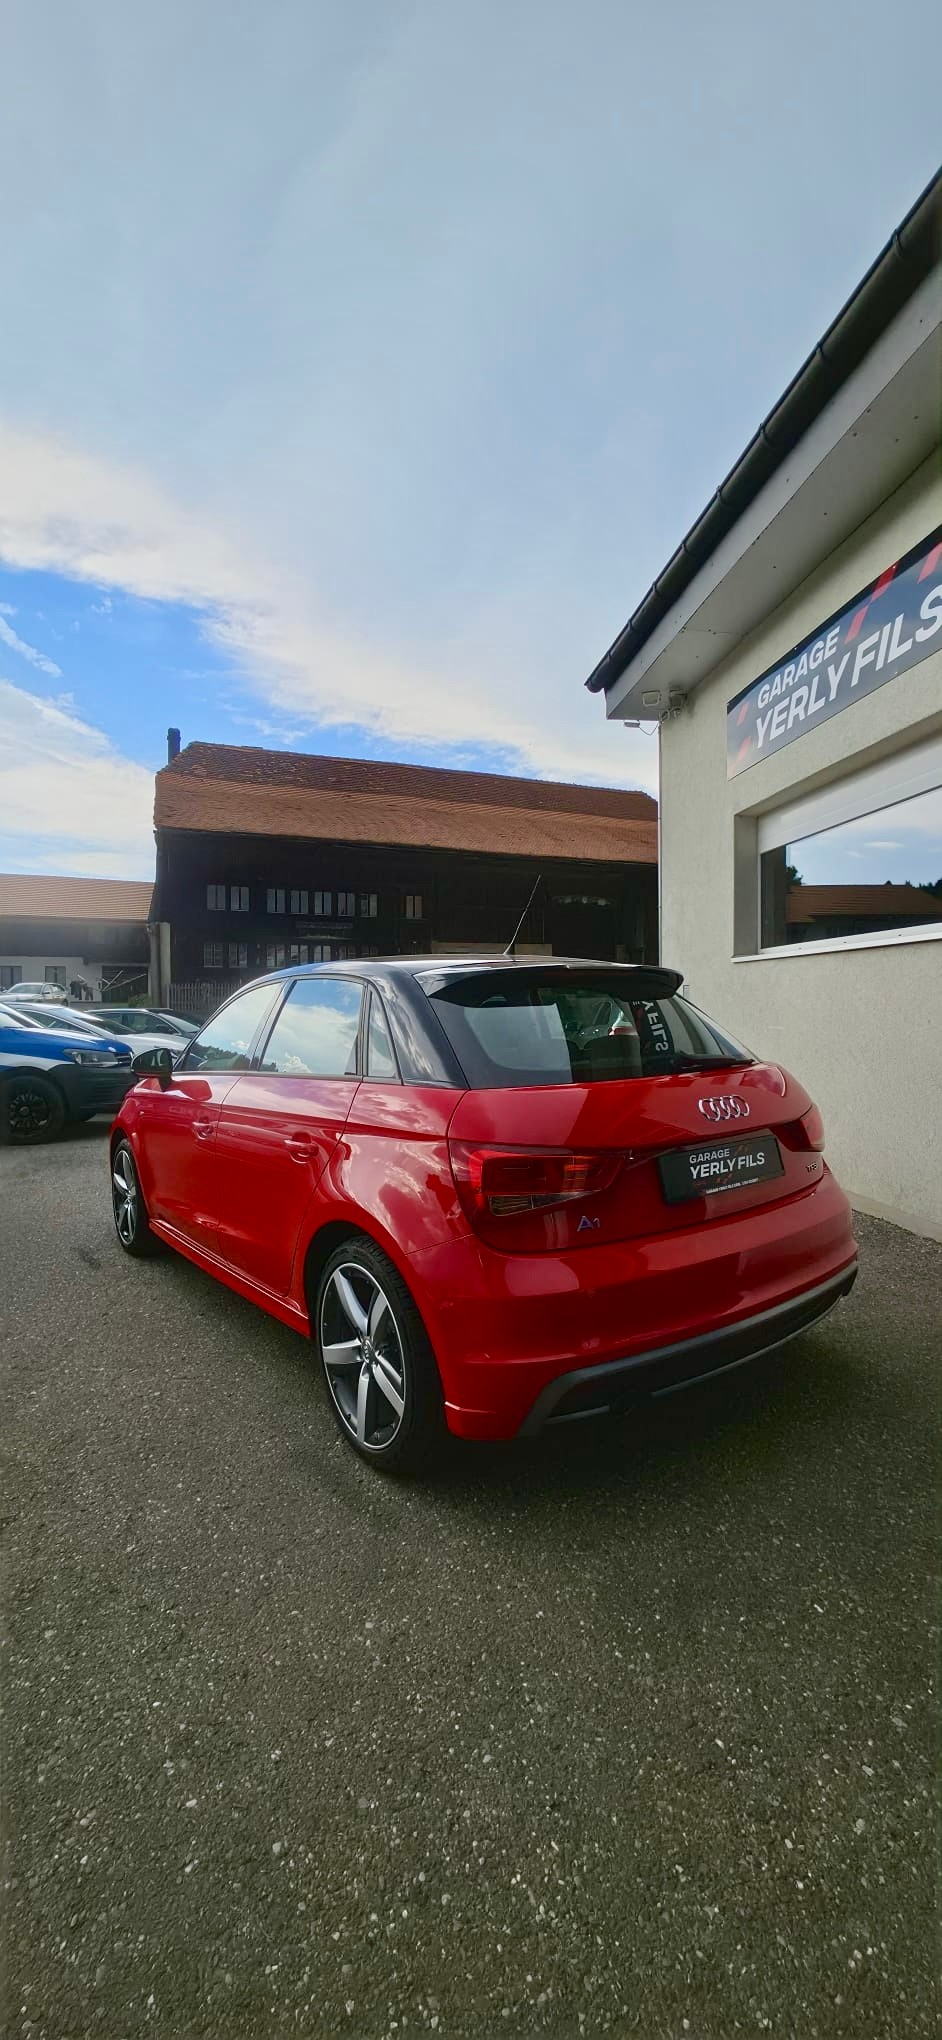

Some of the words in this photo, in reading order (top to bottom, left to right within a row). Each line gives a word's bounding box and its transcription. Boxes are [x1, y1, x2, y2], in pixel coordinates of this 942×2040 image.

[756, 651, 850, 748] YERLY
[851, 584, 942, 688] FILS
[757, 625, 840, 708] GARAGE
[689, 1148, 730, 1164] GARAGE
[690, 1157, 736, 1179] YERLY
[737, 1152, 765, 1170] FILS
[576, 1215, 601, 1232] A1
